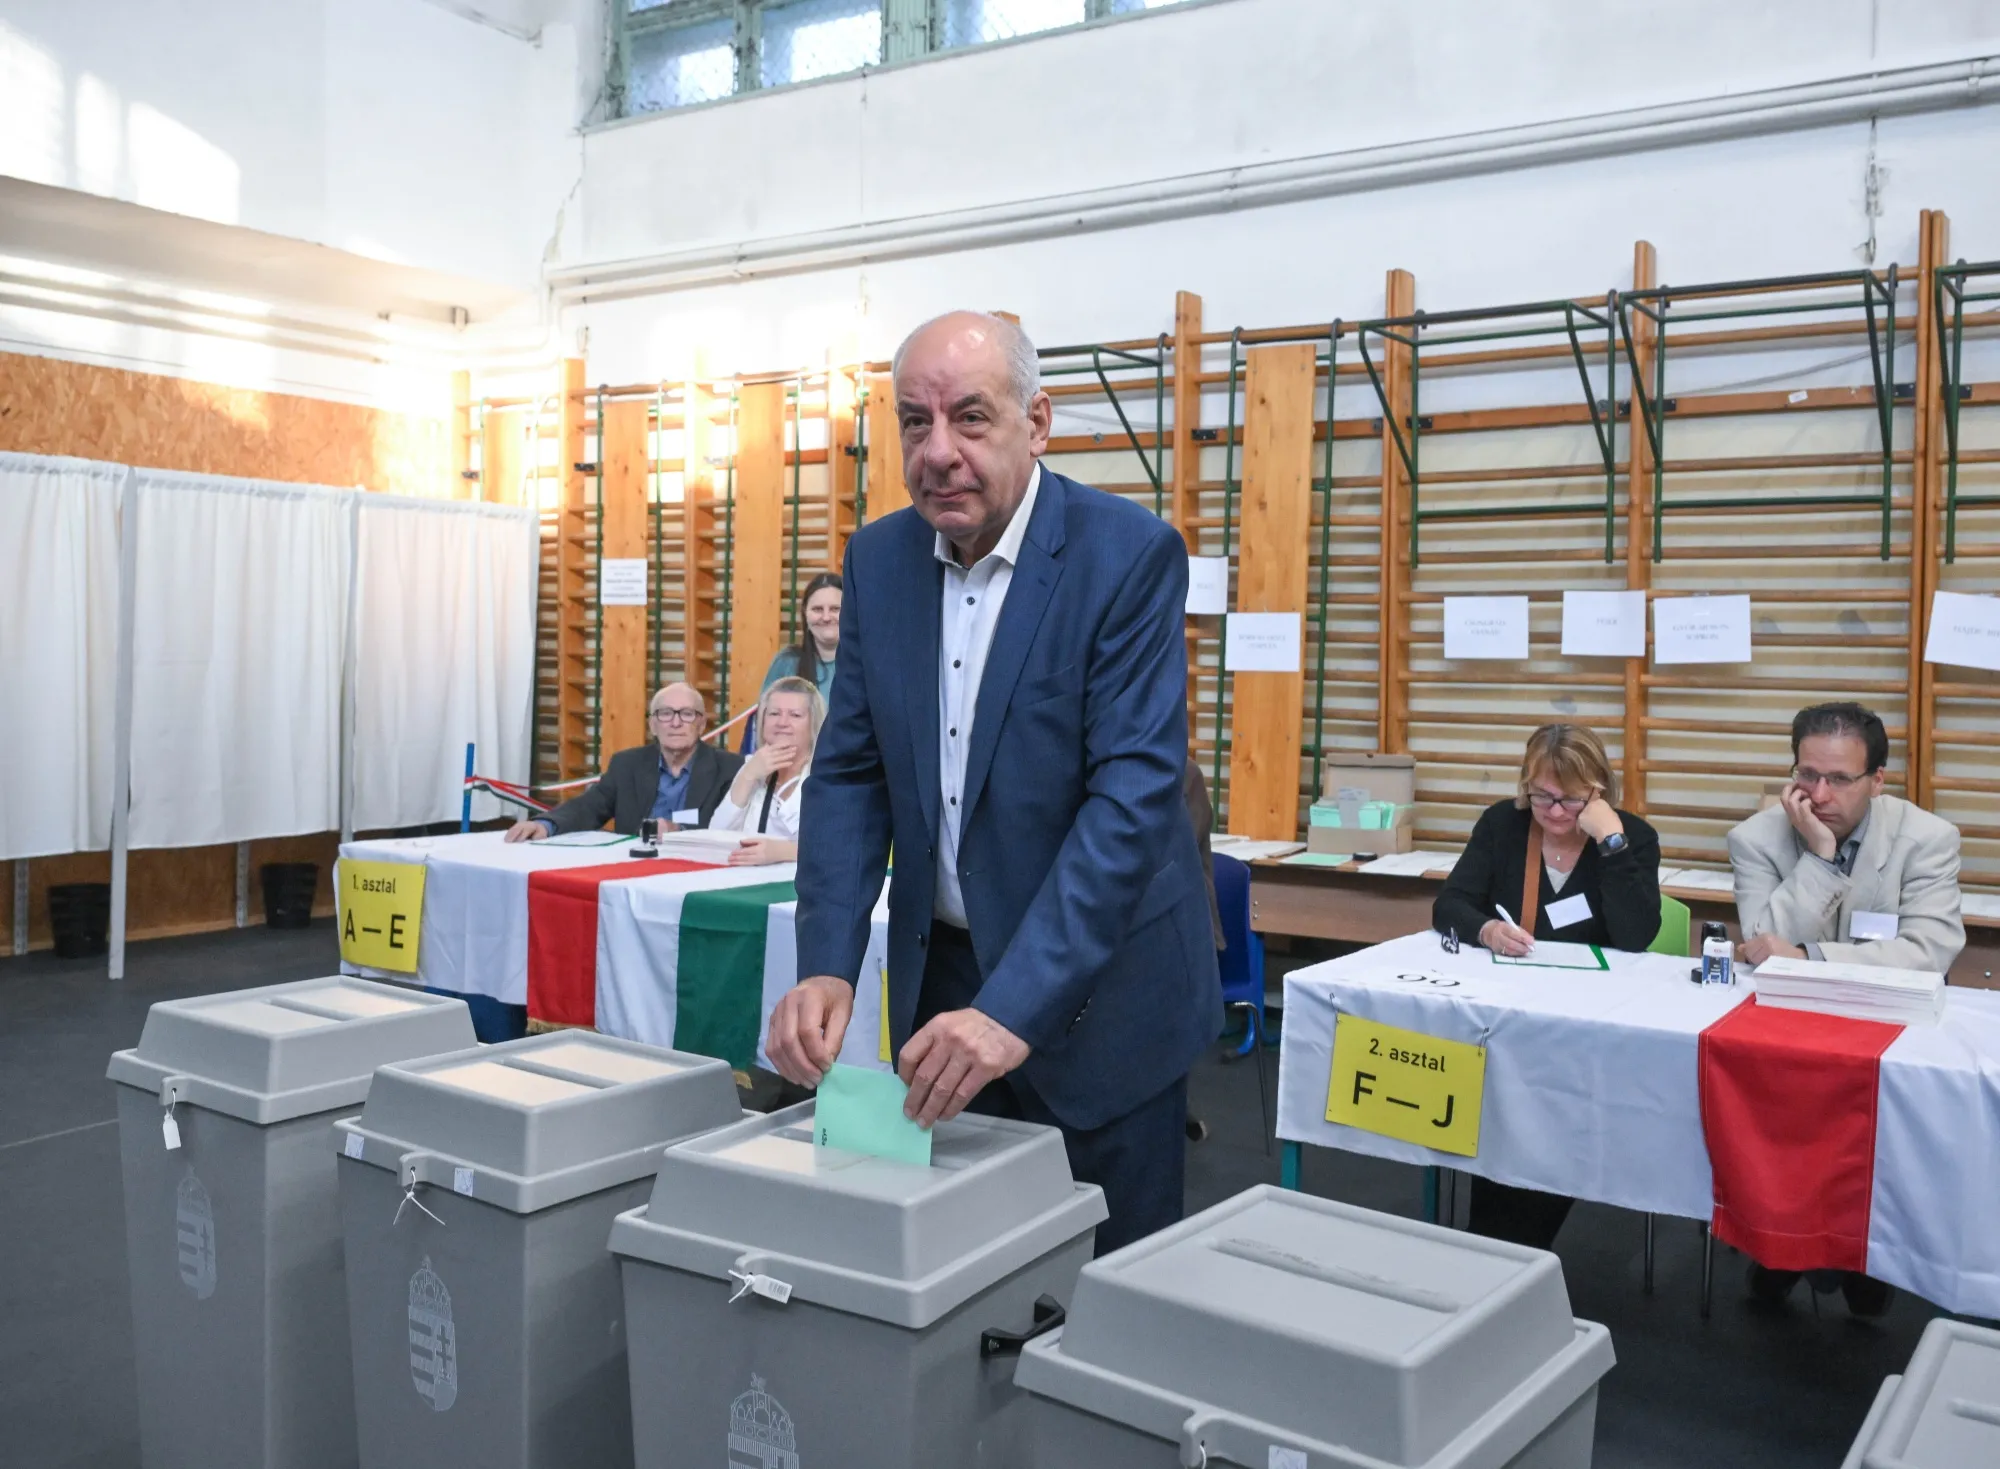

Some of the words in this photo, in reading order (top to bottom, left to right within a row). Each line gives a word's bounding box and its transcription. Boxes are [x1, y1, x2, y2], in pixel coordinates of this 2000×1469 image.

[353, 873, 359, 890] 1.
[362, 877, 396, 894] asztal
[344, 908, 356, 942] A
[389, 913, 407, 949] E
[1369, 1038, 1383, 1057] 2.
[1389, 1047, 1446, 1073] asztal
[1352, 1070, 1377, 1105] F
[1431, 1094, 1455, 1128] J
